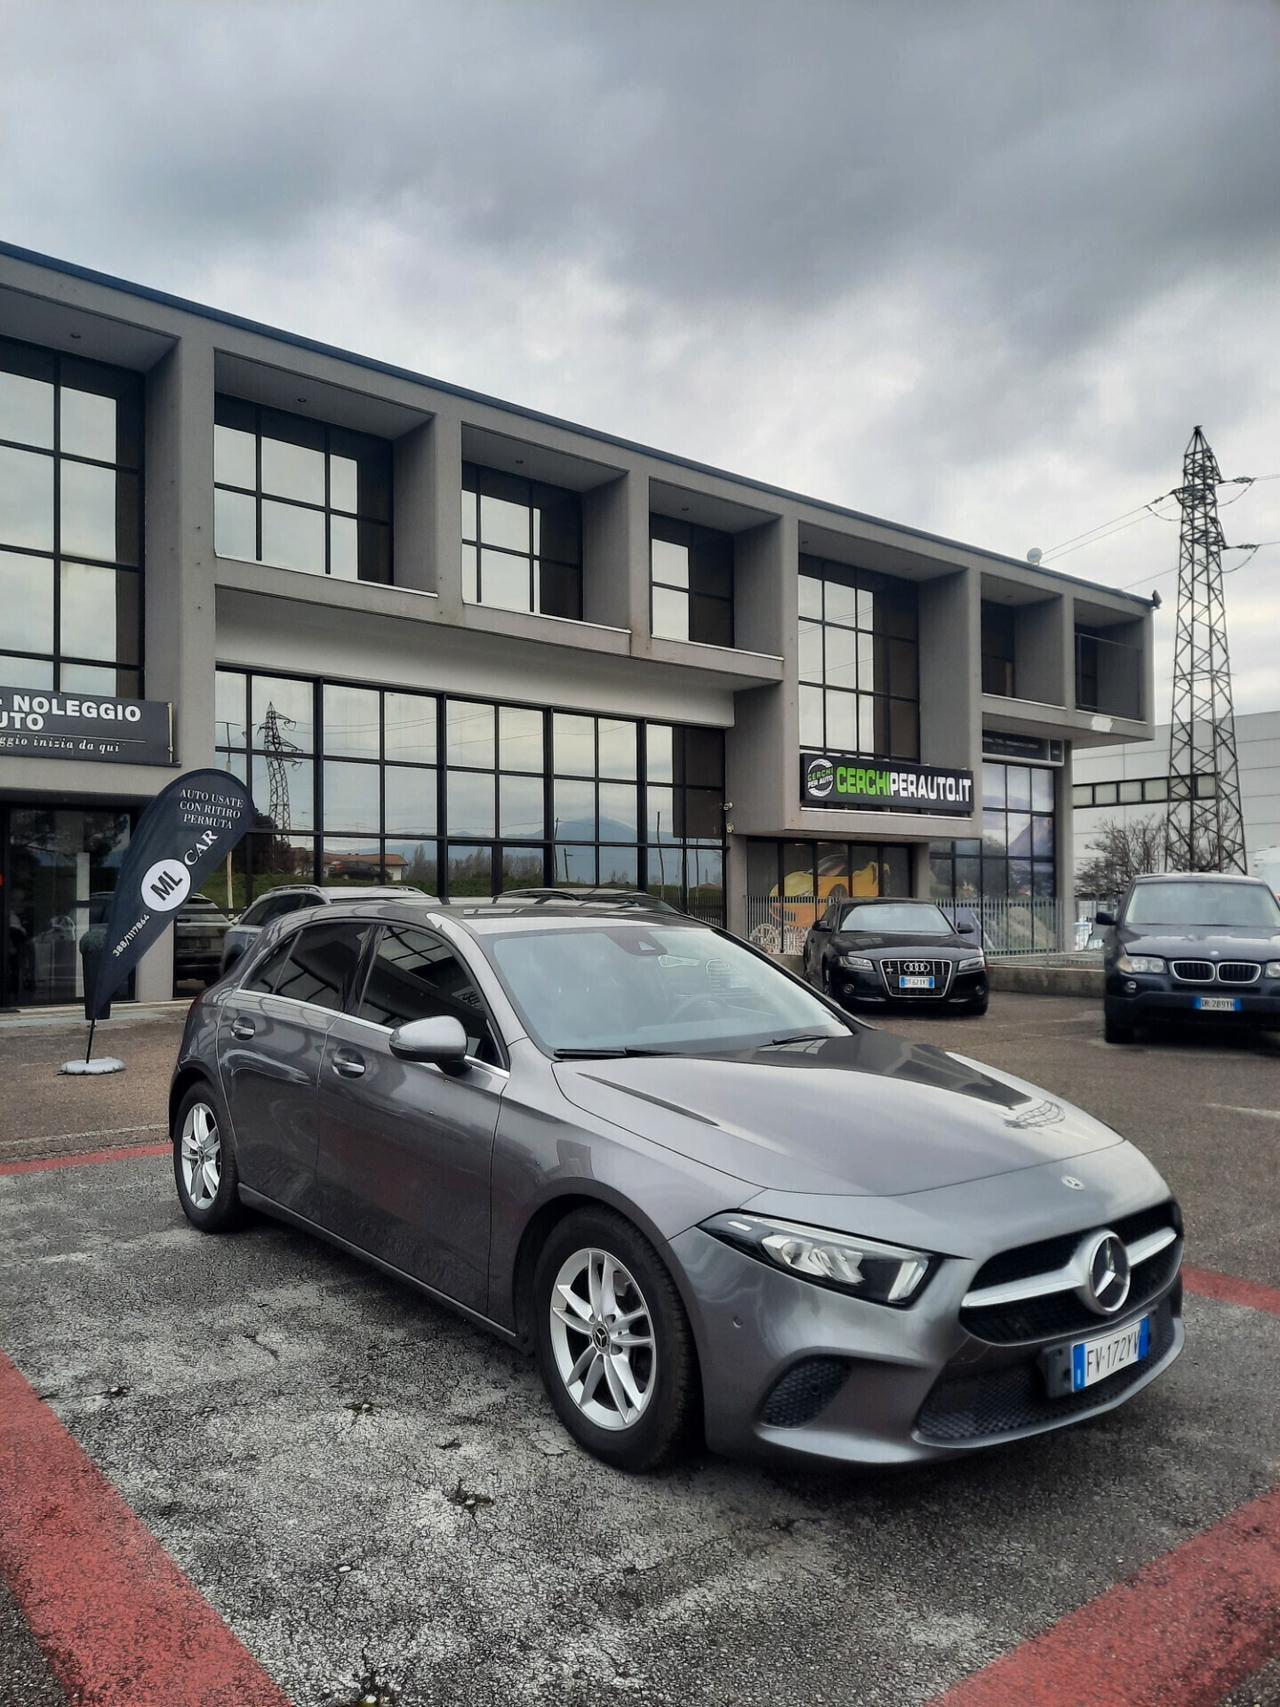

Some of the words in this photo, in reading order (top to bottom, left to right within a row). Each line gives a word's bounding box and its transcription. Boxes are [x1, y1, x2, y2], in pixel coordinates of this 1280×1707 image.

[13, 694, 142, 722] NOLEGGIO
[33, 736, 74, 749] inizia
[79, 739, 94, 750] da
[99, 742, 120, 754] qui
[180, 788, 209, 801] AUTO
[211, 793, 244, 808] USATE
[180, 800, 202, 812] CON
[204, 804, 241, 818] RITIRO
[183, 813, 232, 829] PERMUTA
[184, 830, 218, 865] CAR
[150, 870, 183, 901] ML
